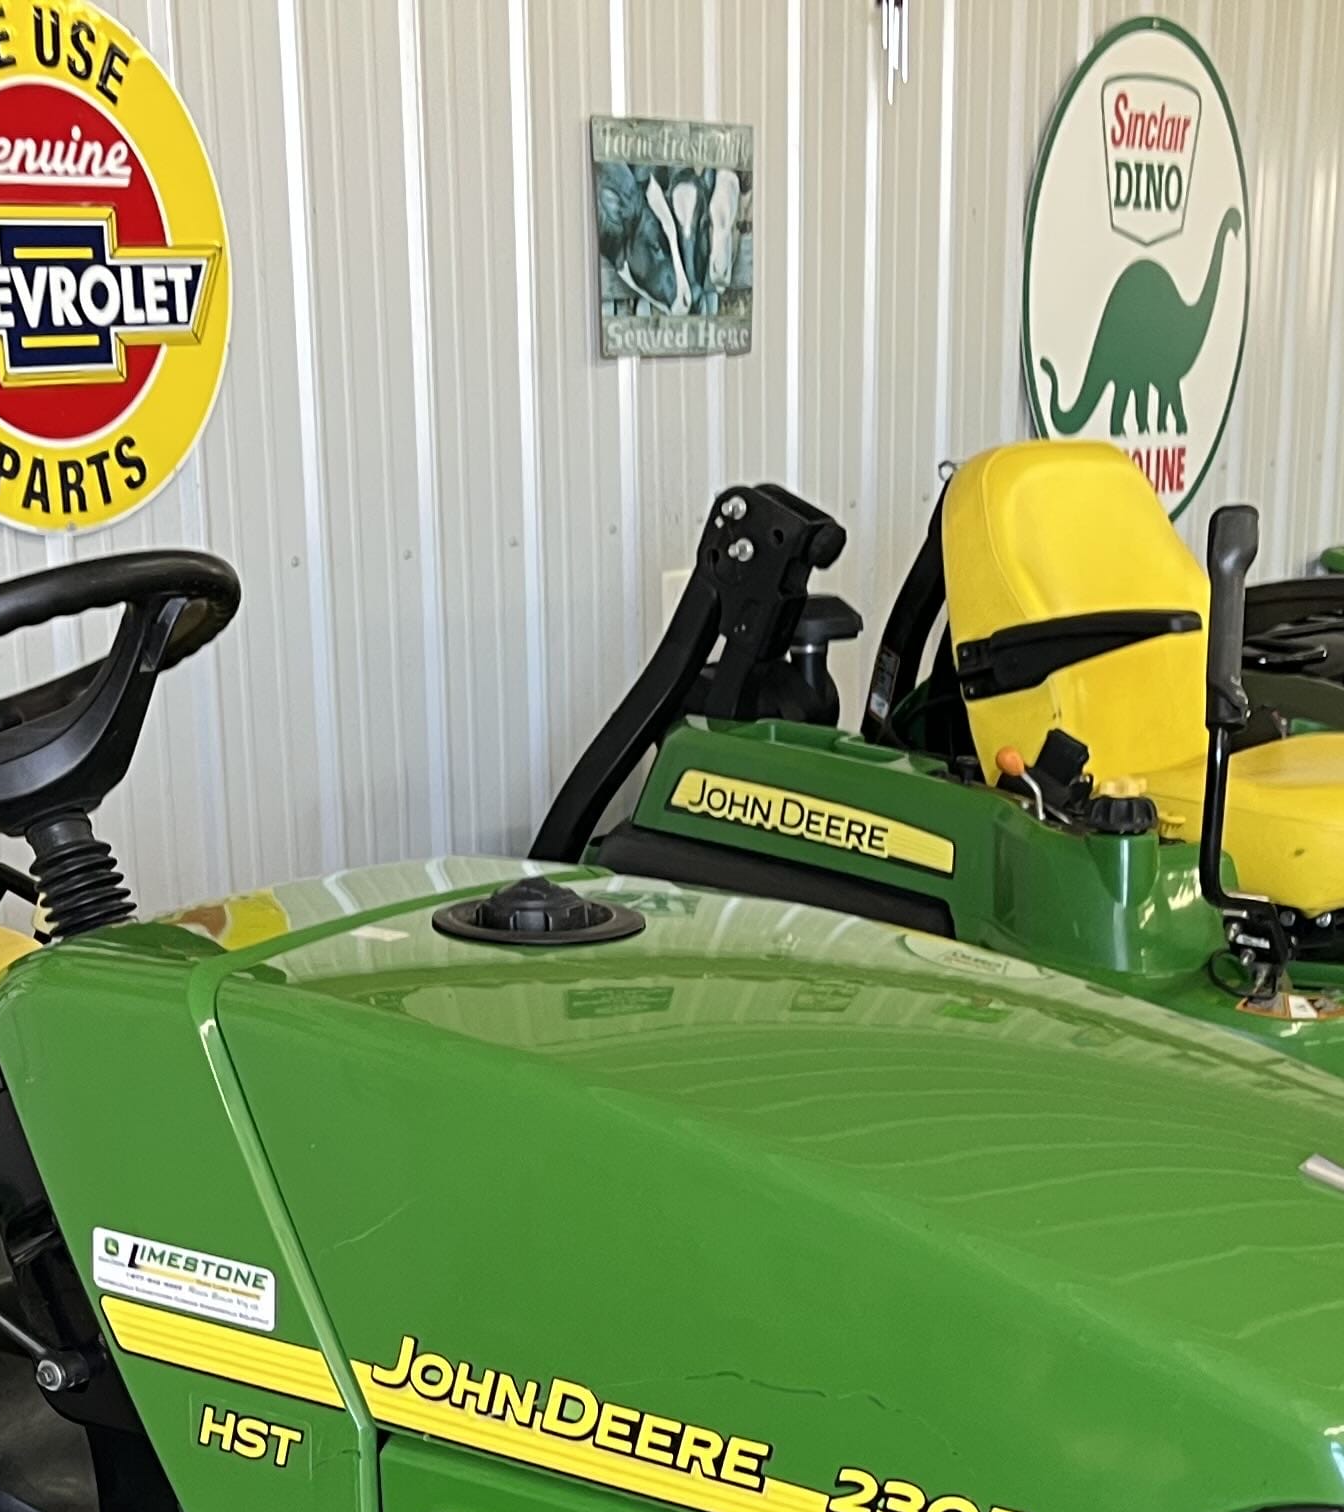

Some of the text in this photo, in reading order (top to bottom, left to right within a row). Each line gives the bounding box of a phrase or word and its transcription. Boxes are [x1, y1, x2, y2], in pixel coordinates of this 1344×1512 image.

[32, 5, 130, 105] USE
[1111, 91, 1191, 153] Sinclair
[1113, 160, 1183, 214] DINO
[688, 777, 890, 852] JOHN DEERE
[128, 1243, 268, 1291] LIMESTONE
[198, 1404, 304, 1467] HST
[370, 1335, 542, 1428] JOHN
[541, 1376, 772, 1489] DEERE
